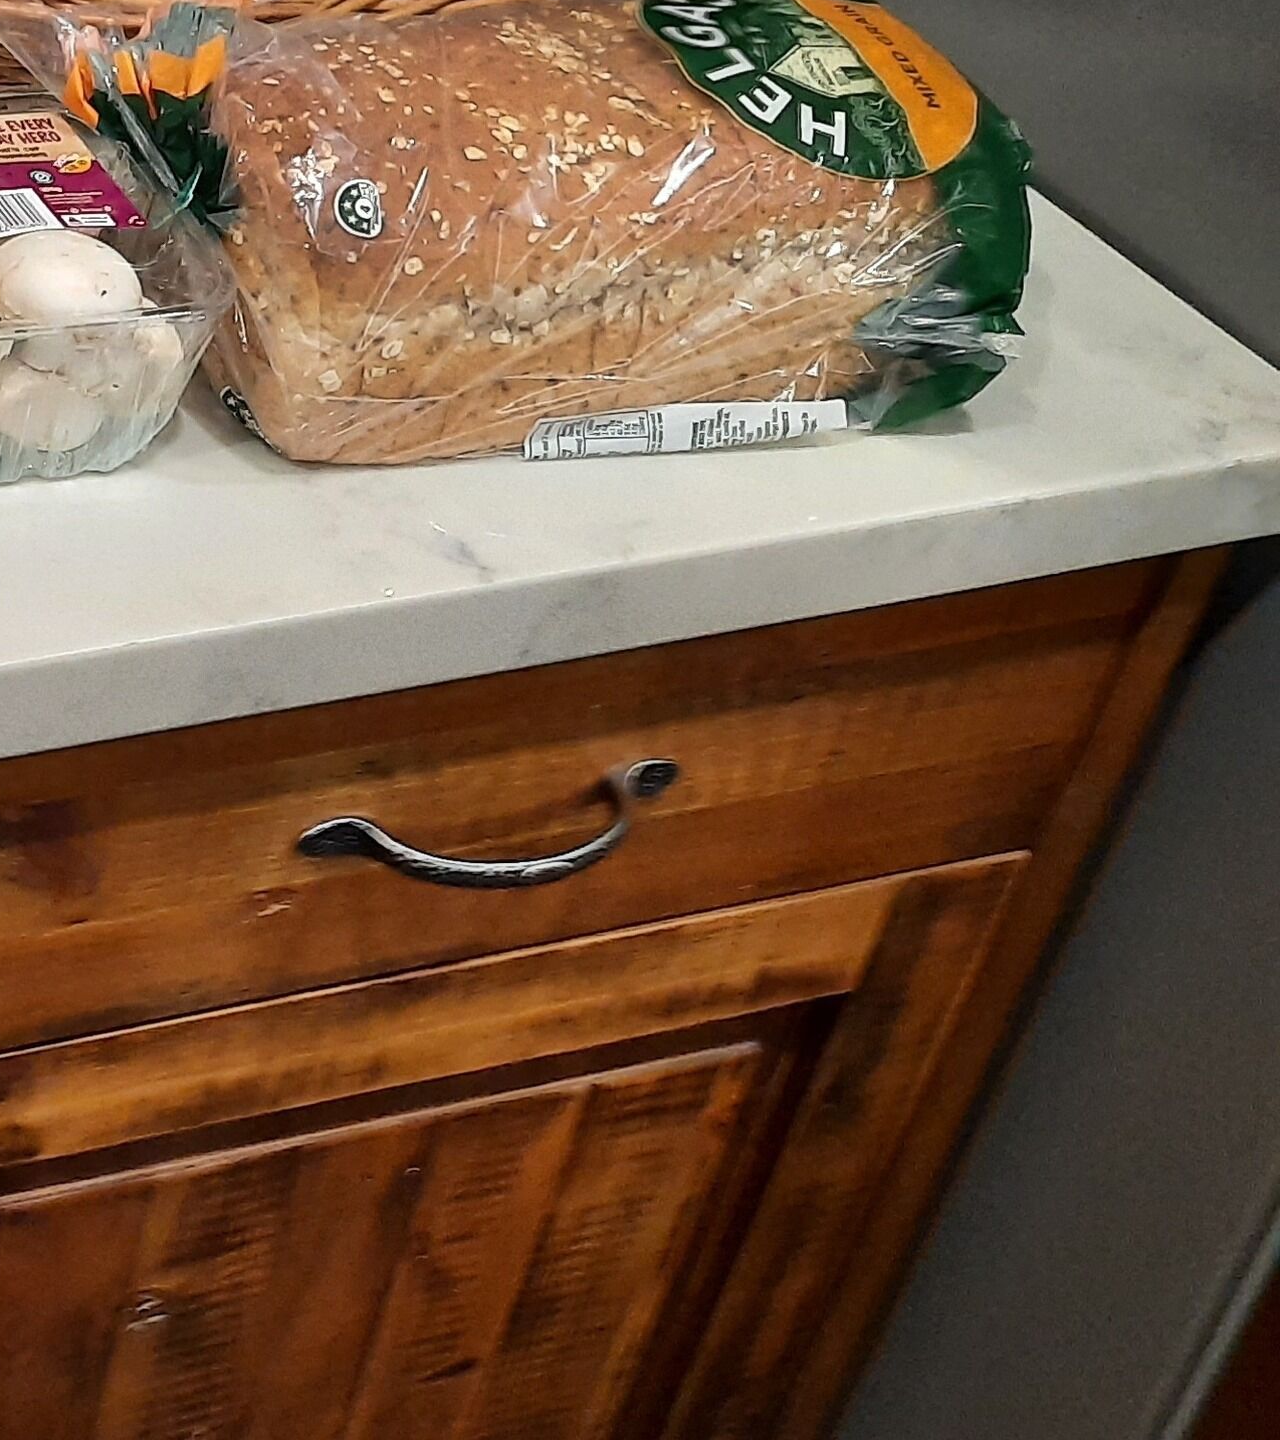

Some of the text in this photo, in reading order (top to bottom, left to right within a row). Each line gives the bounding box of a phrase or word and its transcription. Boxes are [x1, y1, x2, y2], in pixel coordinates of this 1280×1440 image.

[833, 3, 942, 110] MIXED GRAIN
[5, 118, 56, 132] EVERY
[15, 130, 62, 145] HERO
